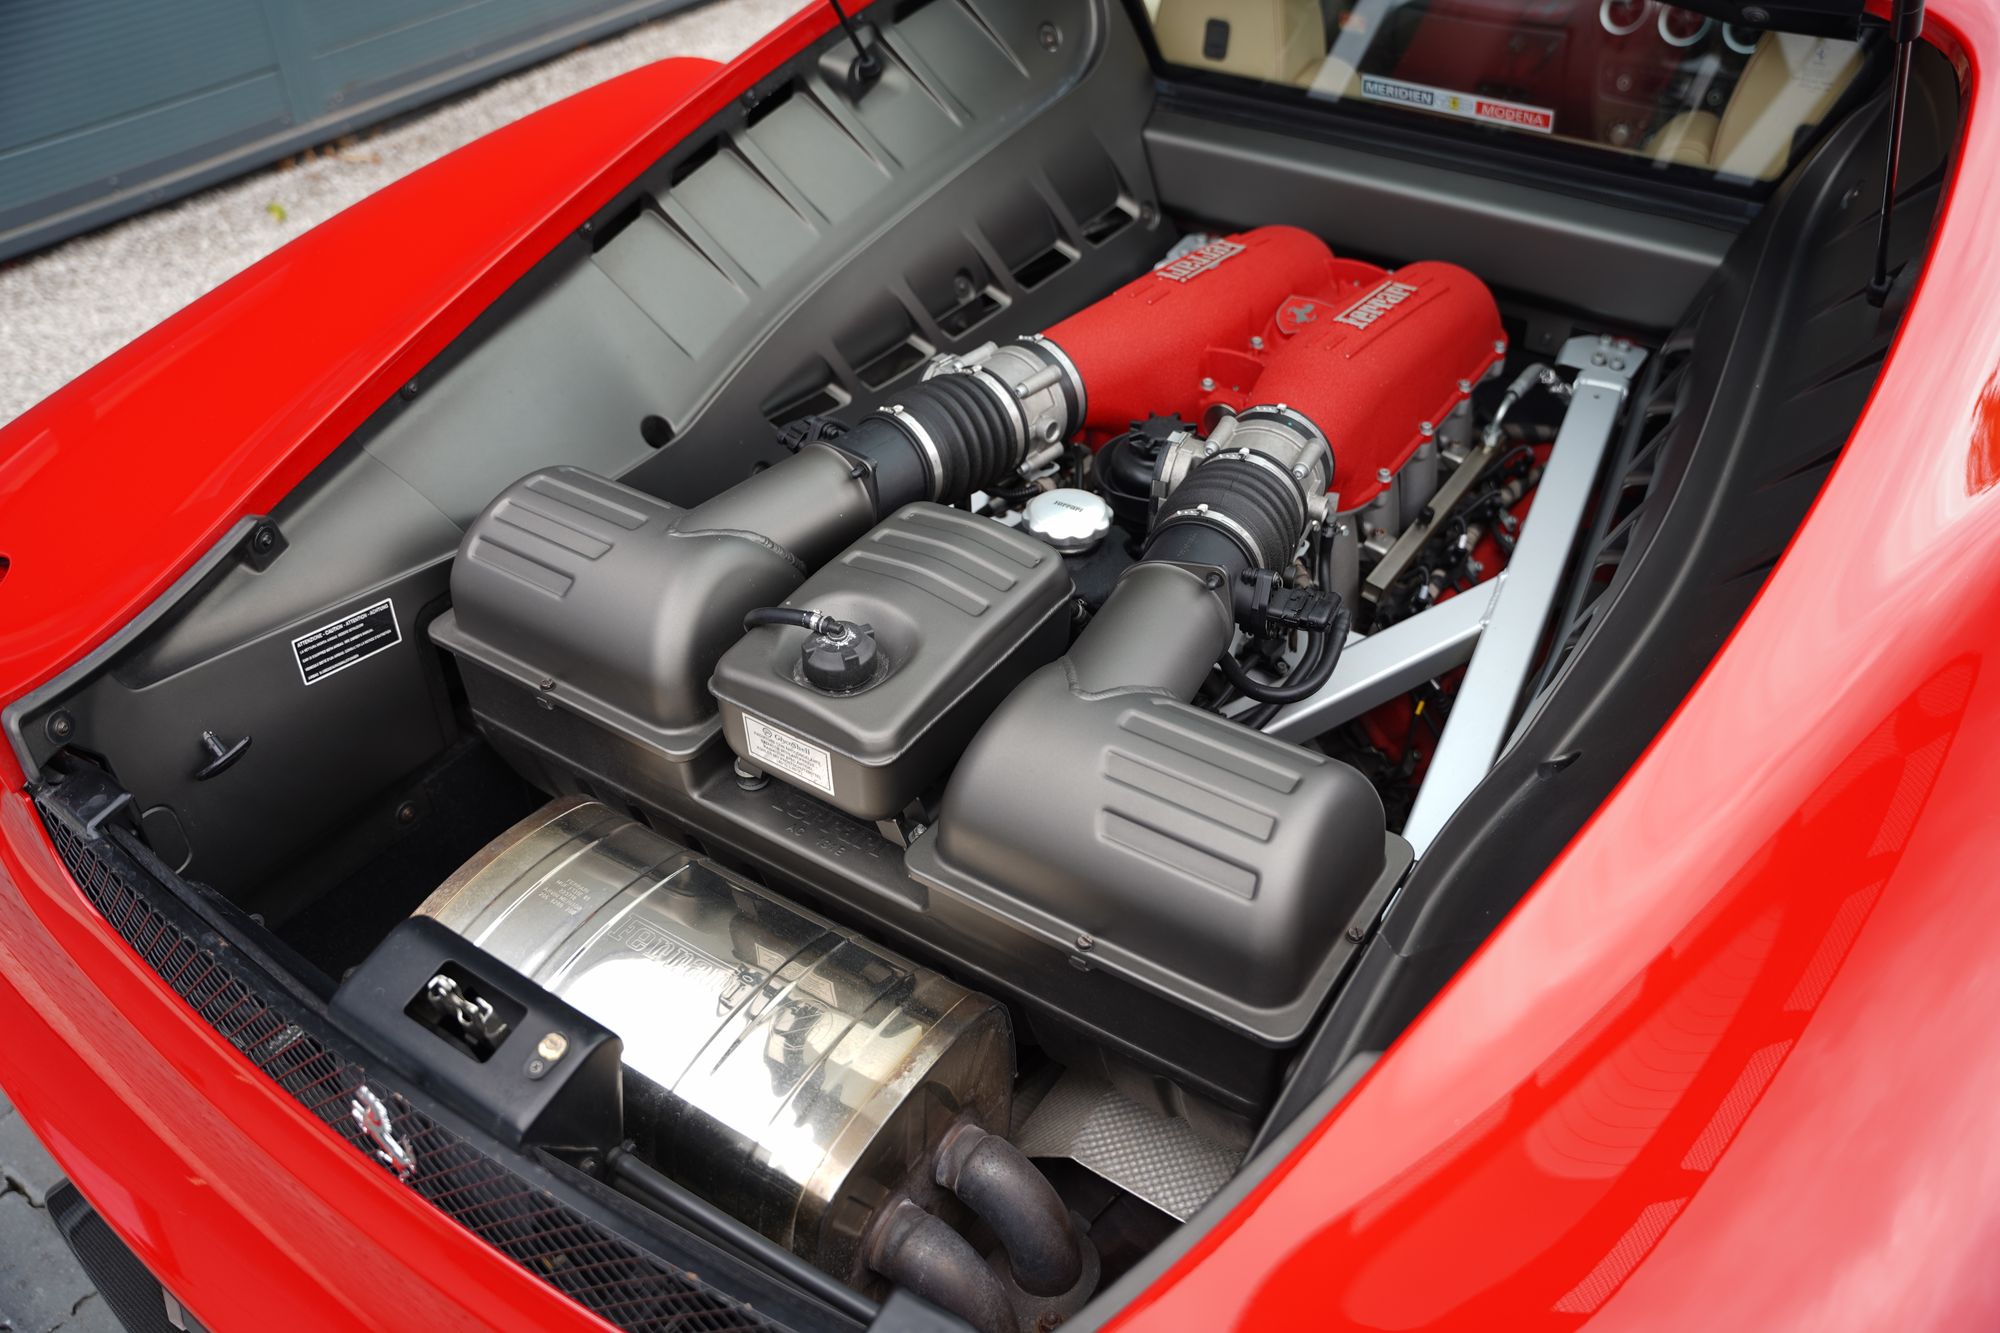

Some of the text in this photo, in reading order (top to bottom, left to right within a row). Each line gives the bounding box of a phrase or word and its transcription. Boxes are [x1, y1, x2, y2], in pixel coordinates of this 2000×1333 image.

[1365, 81, 1544, 128] MERIDIEN MODENA
[1156, 239, 1246, 282] Ferrari
[1333, 280, 1418, 330] Ferrari
[1054, 500, 1084, 512] Ferrari
[608, 913, 742, 1002] Ferrari
